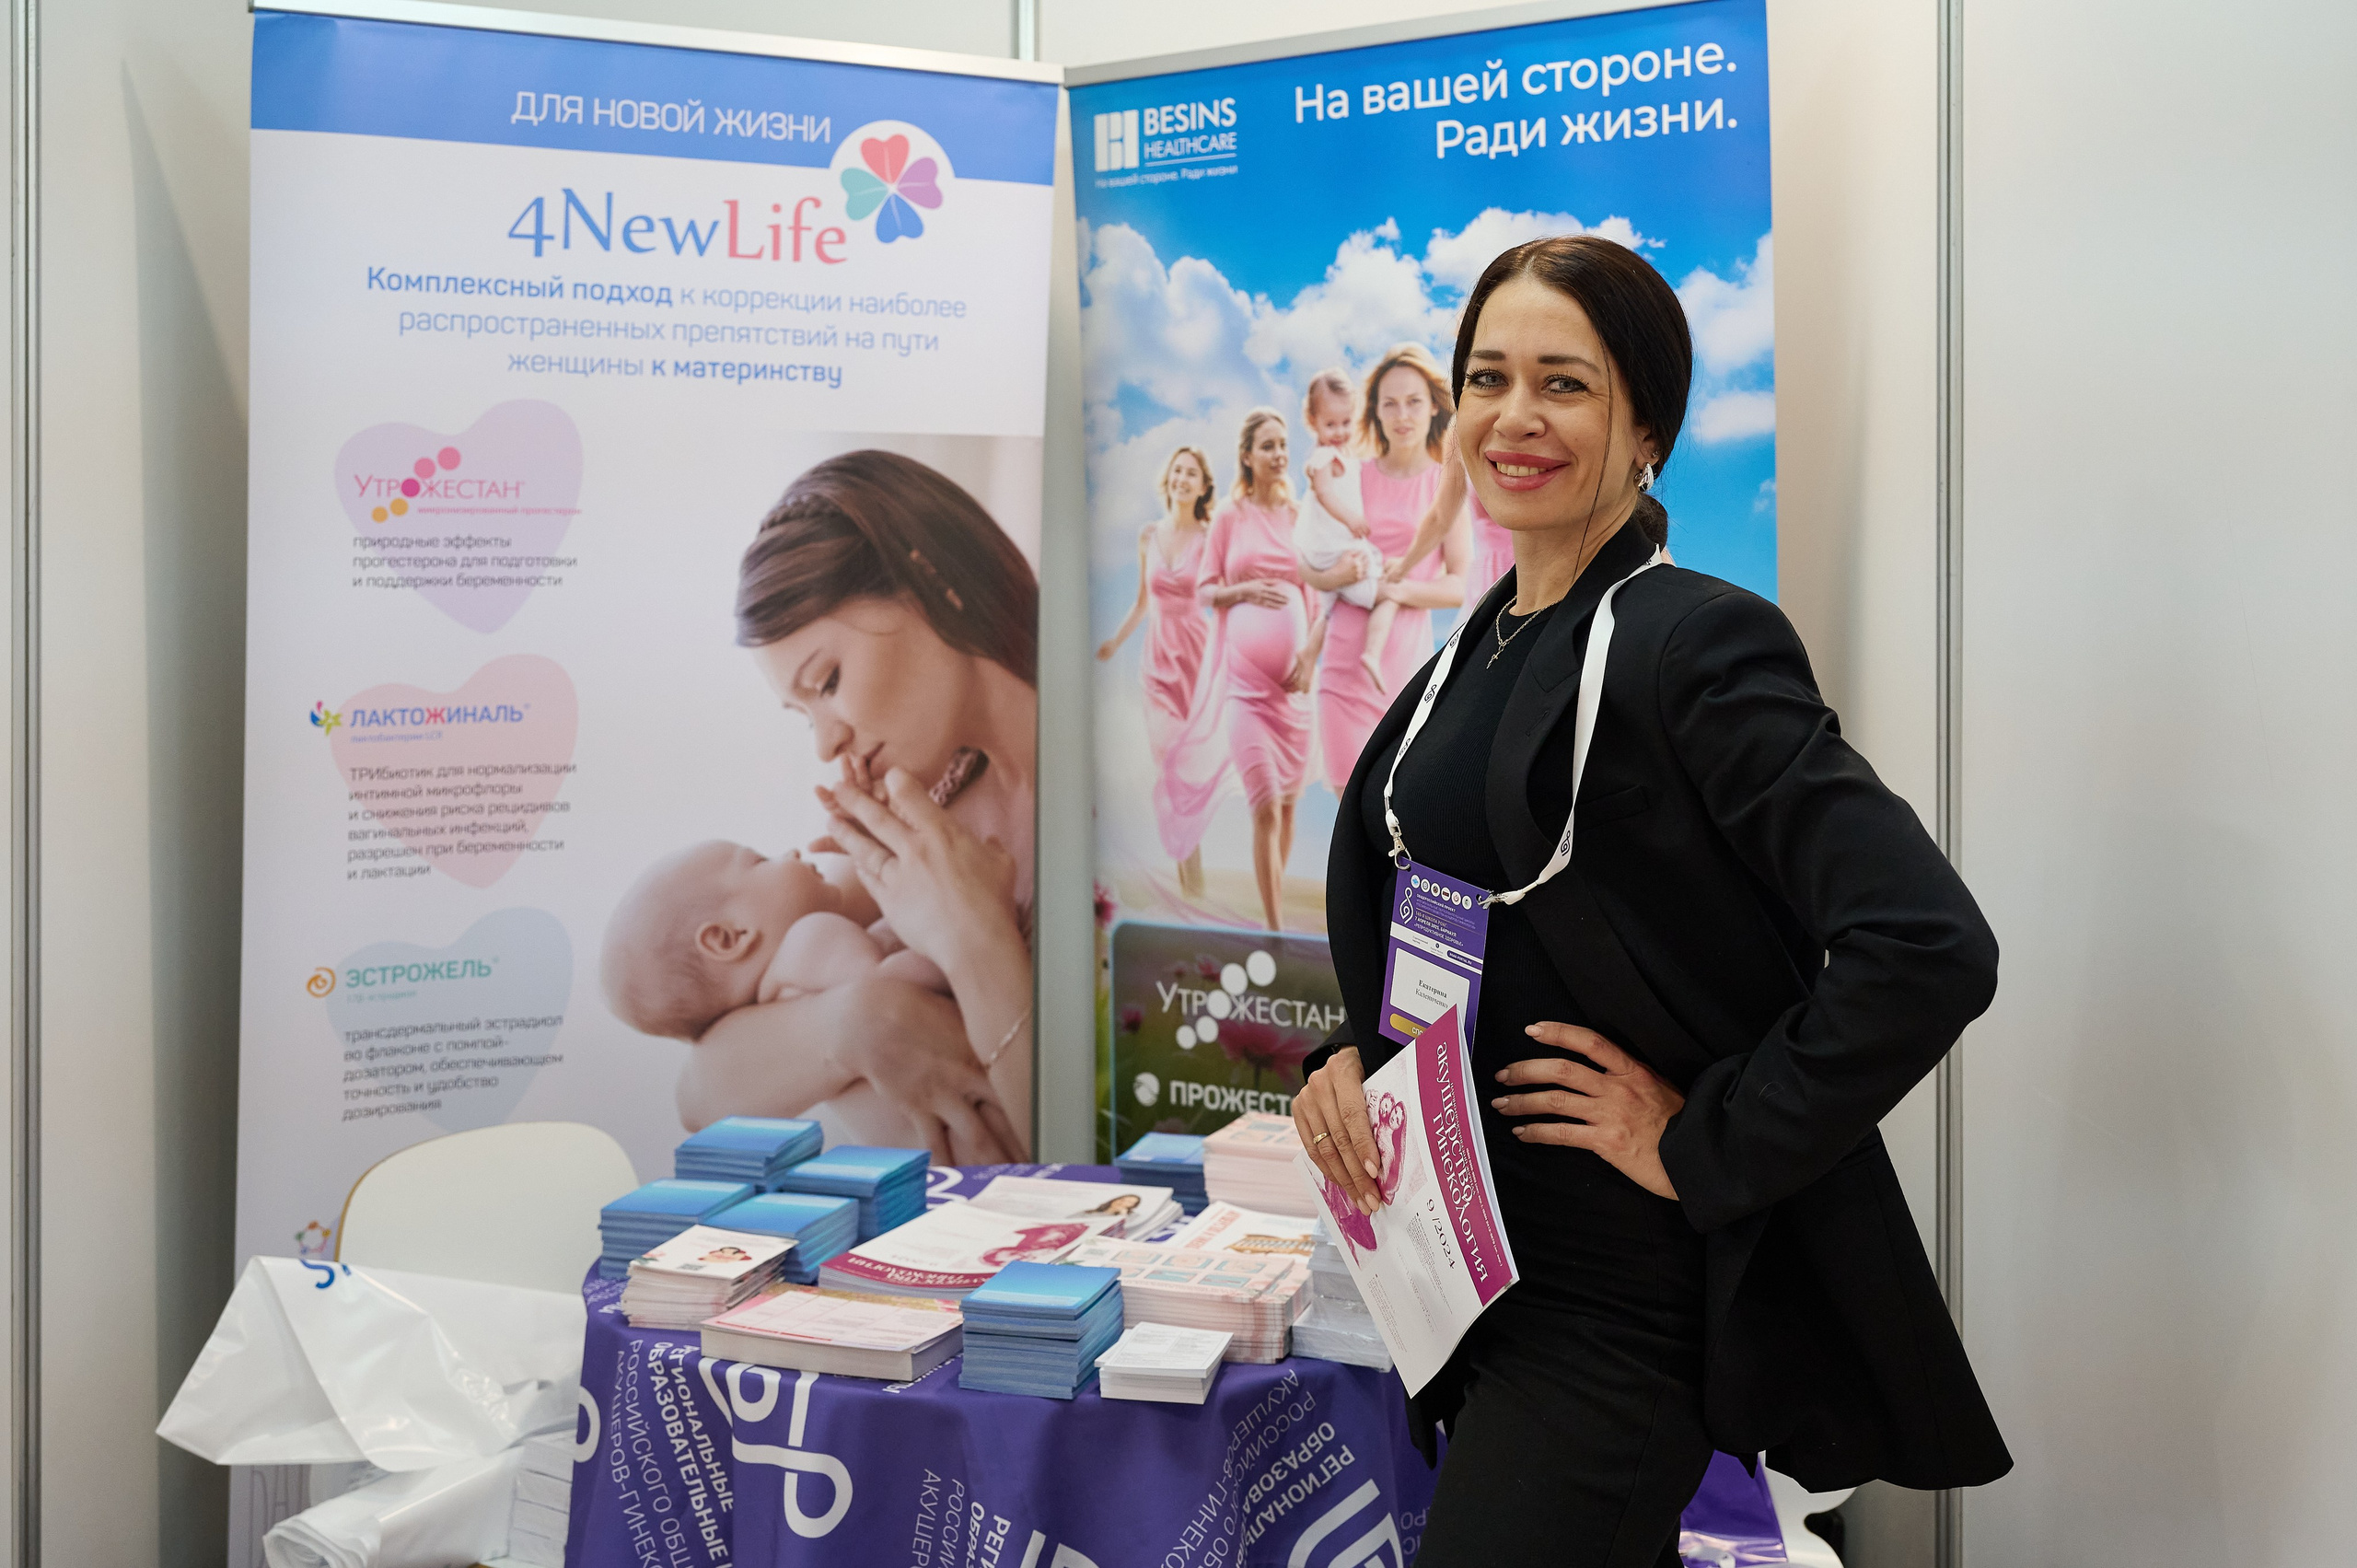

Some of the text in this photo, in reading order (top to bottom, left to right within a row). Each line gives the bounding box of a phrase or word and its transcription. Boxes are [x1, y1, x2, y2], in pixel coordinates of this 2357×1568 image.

[1295, 42, 1738, 122] На вашей стороне.
[510, 90, 831, 145] ДЛЯ НОВОЙ ЖИЗНИ
[1144, 97, 1237, 136] BESINS
[1436, 98, 1738, 160] Ради жизни.
[1144, 132, 1237, 159] HEALTHCARE
[507, 188, 850, 266] 4NewLife
[367, 266, 968, 319] Комплексный подход к коррекции наиболее
[399, 309, 940, 355] распространенных препятствий на пути
[507, 350, 842, 389] женщины к материнству
[353, 535, 512, 550] природные эффекты
[353, 555, 578, 569] прогестерона для подготовки
[353, 573, 563, 589] и поддержки беременности
[350, 704, 524, 729] ЛАКТОЖИНАЛЬ
[436, 766, 464, 778] для
[468, 763, 577, 777] нормализации
[349, 783, 523, 801] интимной микрофлоры
[362, 806, 437, 821] снижения
[441, 803, 485, 819] риска
[348, 826, 447, 842] вагинальных
[425, 844, 454, 858] при
[457, 839, 564, 855] беременности
[360, 865, 431, 880] лактации
[345, 958, 492, 989] ЭСТРОЖЕЛЬ
[1419, 979, 1447, 998] Екатерина
[345, 1015, 563, 1043] трансдермальный эстрадиол
[365, 1043, 430, 1061] флаконе
[343, 1085, 411, 1100] точность
[427, 1075, 498, 1094] удобство
[1169, 1079, 1293, 1115] ПРОЖЕСТ
[342, 1098, 441, 1121] дозирования
[1427, 1199, 1434, 1212] 9
[610, 1351, 663, 1568] АКУШЕРОВ-ГИНЕК
[627, 1339, 693, 1568] РОССИЙСКОГО ОБЩ
[647, 1342, 728, 1561] ОБРАЗОВАТЕЛЬНЫЕ
[1159, 1368, 1299, 1568] АКУШЕРОВ-ГИНЕКО
[1243, 1445, 1355, 1548] РЕГИОНАЛЬ
[911, 1469, 941, 1568] АКУШЕР
[938, 1479, 964, 1568] РОССИ
[967, 1502, 984, 1568] ОБРА
[981, 1515, 1011, 1568] РЕГИ
